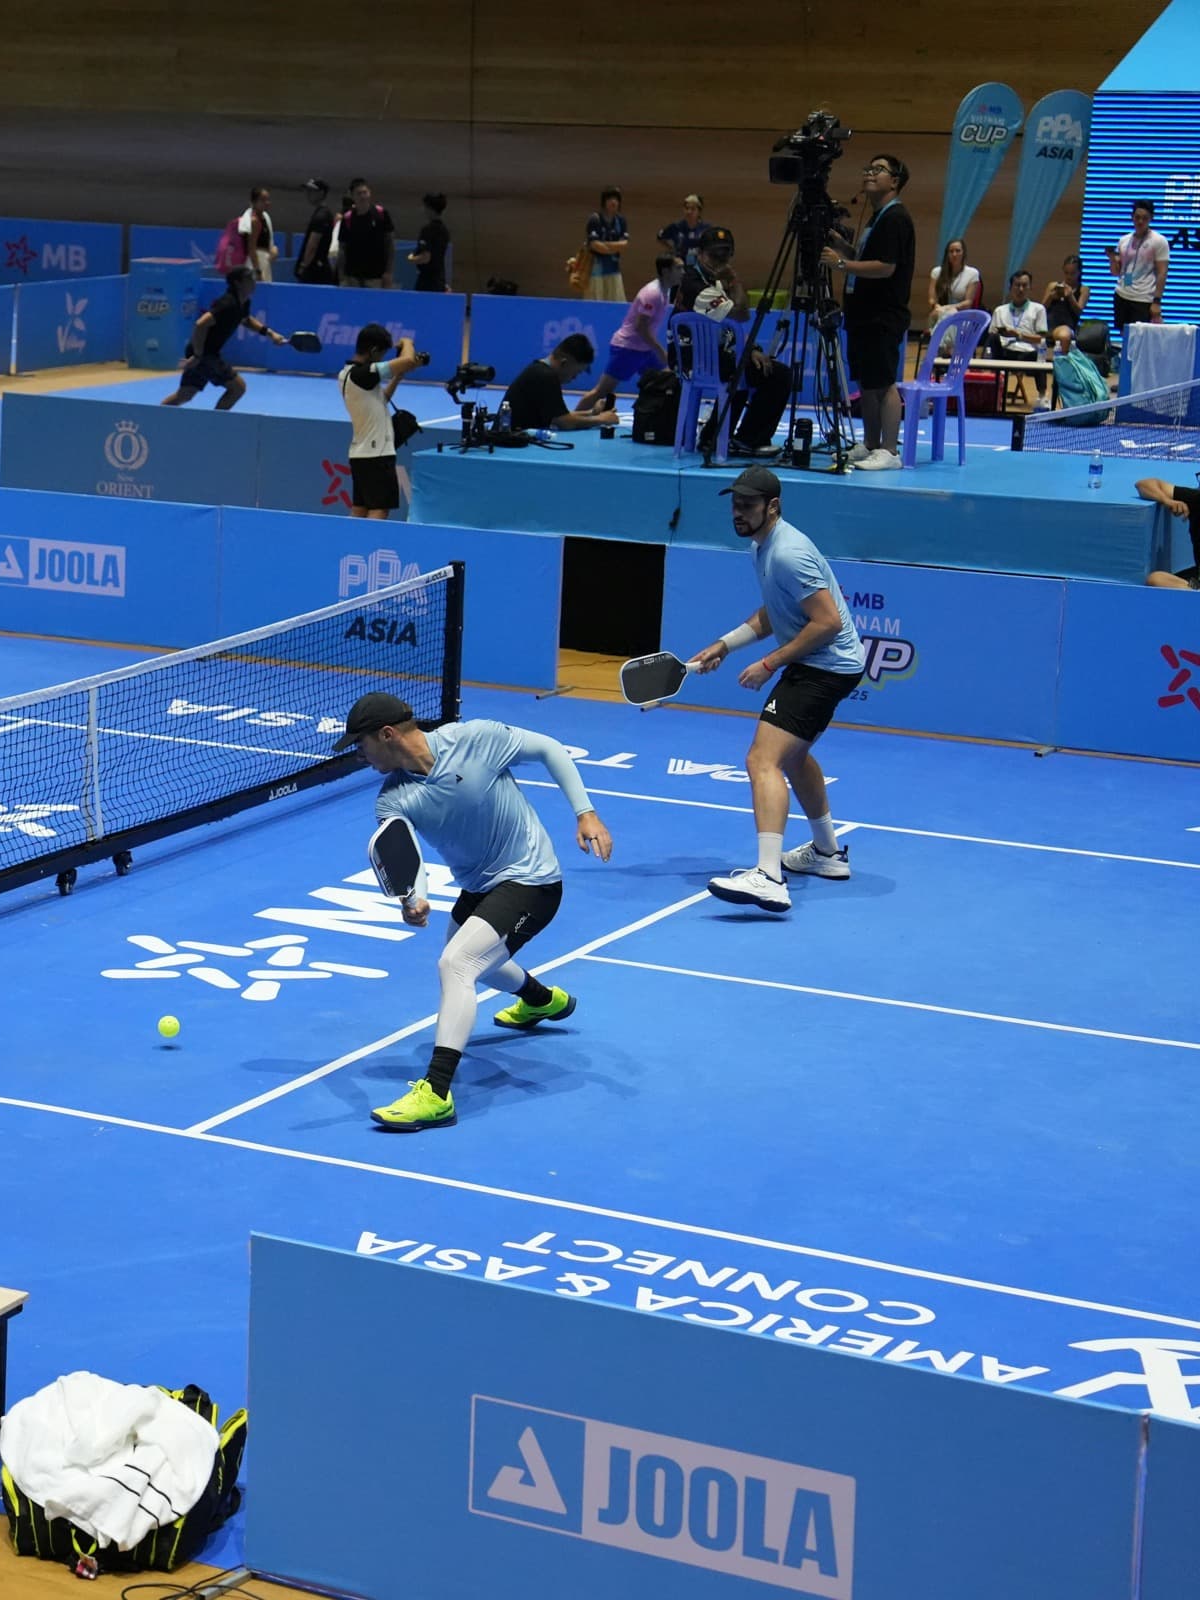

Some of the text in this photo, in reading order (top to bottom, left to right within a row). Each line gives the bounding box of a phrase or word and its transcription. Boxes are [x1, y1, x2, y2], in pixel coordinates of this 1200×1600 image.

[960, 123, 1008, 145] CUP
[1036, 146, 1075, 161] ASIA
[41, 243, 88, 273] MB
[96, 480, 155, 499] ORIENT
[34, 547, 121, 588] JOOLA
[852, 592, 885, 610] MB
[344, 615, 418, 648] ASIA
[502, 1231, 937, 1327] CONNECT
[355, 1230, 1051, 1386] AMERICA & ASIA
[597, 1445, 839, 1579] JOOLA
